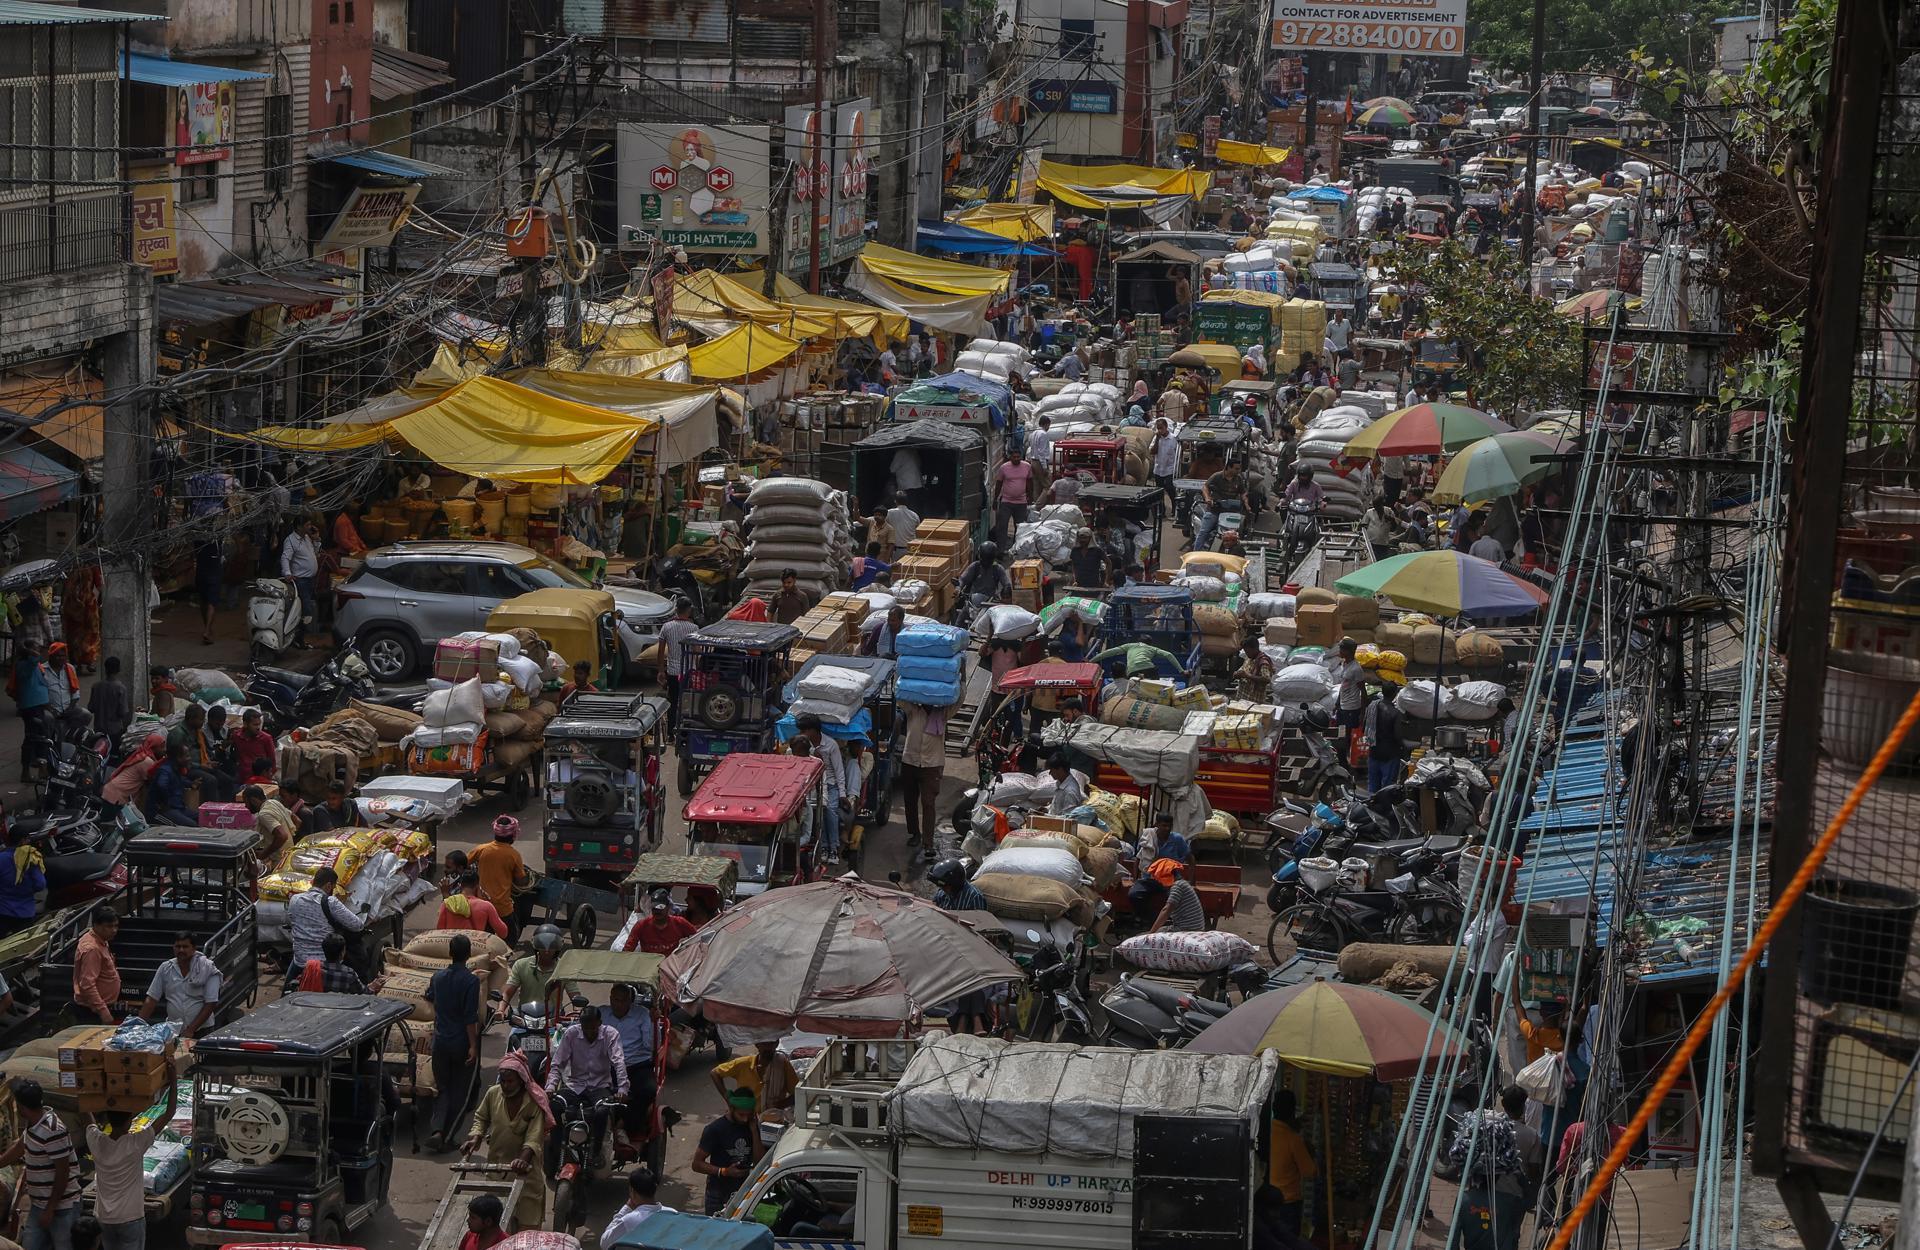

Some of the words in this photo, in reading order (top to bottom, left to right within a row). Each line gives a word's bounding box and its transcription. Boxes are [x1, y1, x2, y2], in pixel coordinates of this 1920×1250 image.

[1282, 7, 1335, 18] CONTACT
[1337, 9, 1360, 20] FOR
[1362, 10, 1457, 22] ADVERTISEMENT
[1281, 22, 1457, 50] 9728840070
[1045, 90, 1062, 101] SBI
[655, 172, 673, 184] M
[711, 173, 729, 186] H
[678, 234, 691, 244] DI
[694, 234, 728, 245] HATTI
[988, 1171, 1035, 1186] DELHI
[1047, 1173, 1072, 1188] U.P
